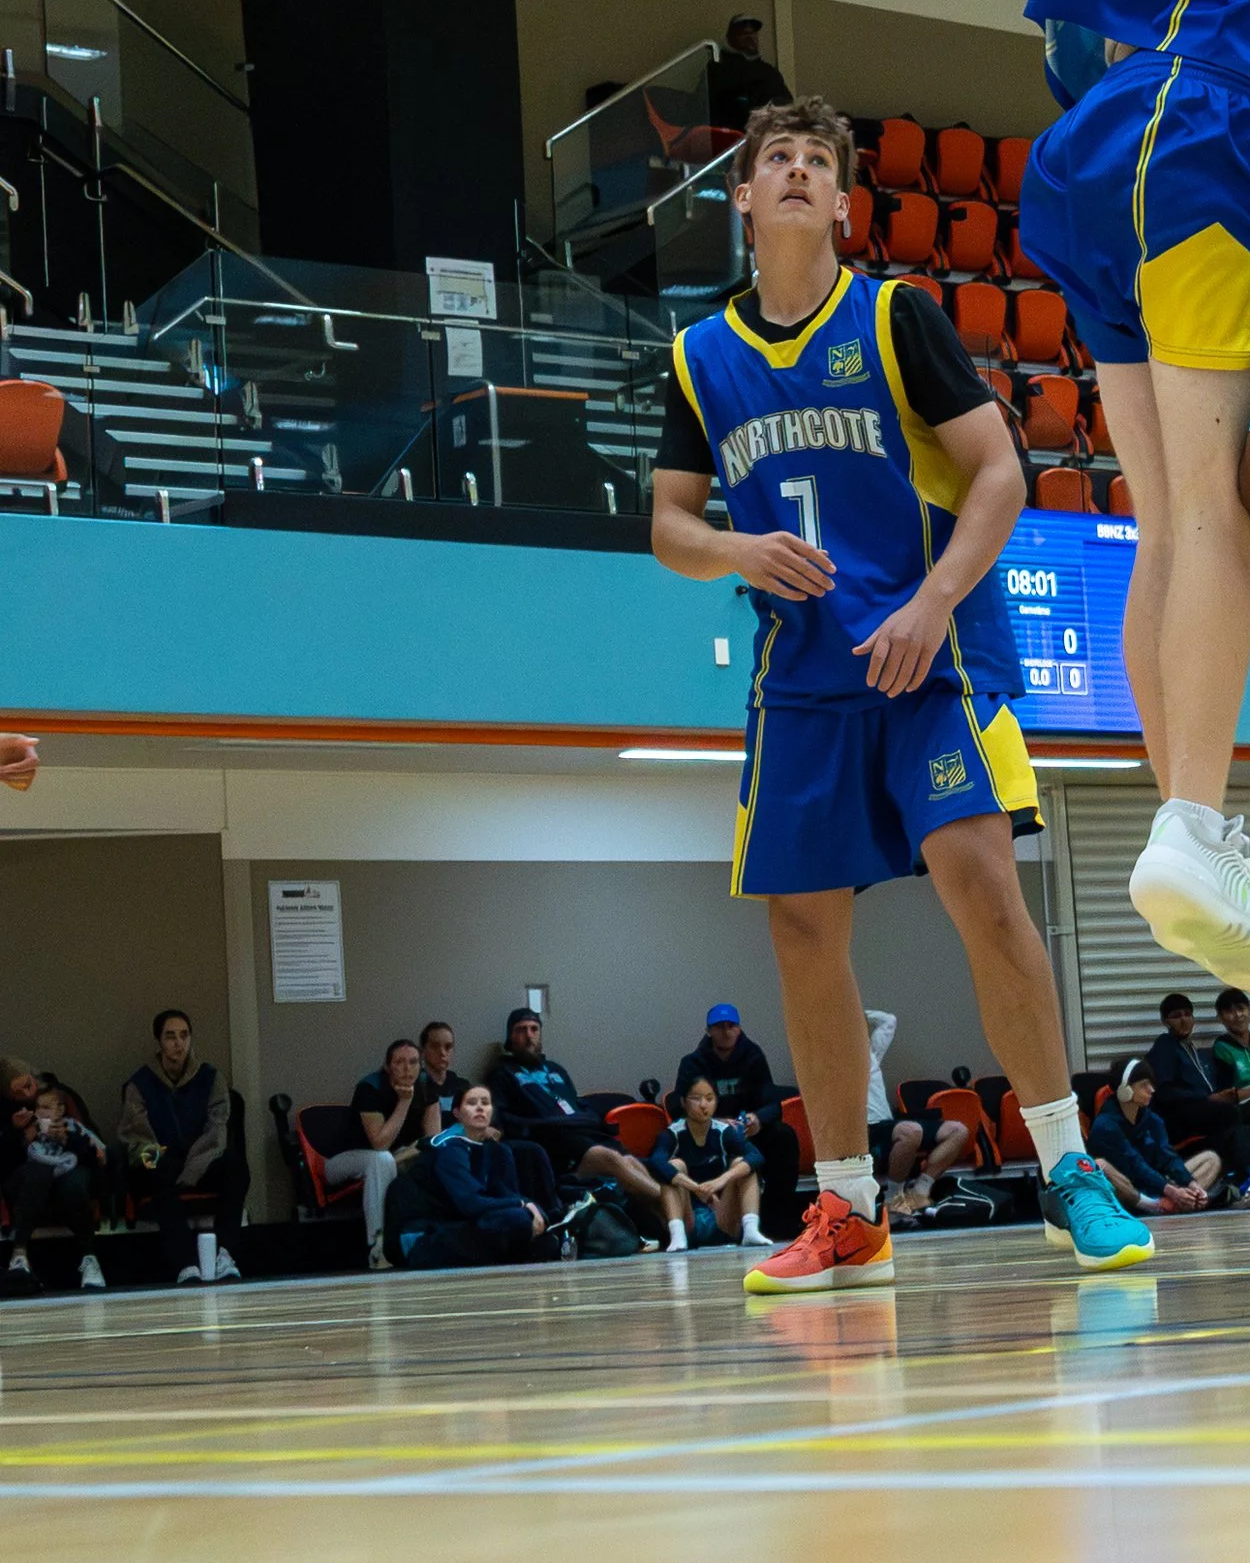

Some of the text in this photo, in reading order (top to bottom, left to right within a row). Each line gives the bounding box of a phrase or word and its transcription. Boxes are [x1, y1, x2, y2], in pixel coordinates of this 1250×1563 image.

[719, 407, 888, 488] NORTHCOTE
[1007, 569, 1057, 598] 08:01
[1063, 628, 1078, 655] 0
[1029, 668, 1050, 687] 0.0
[1069, 670, 1081, 689] 0
